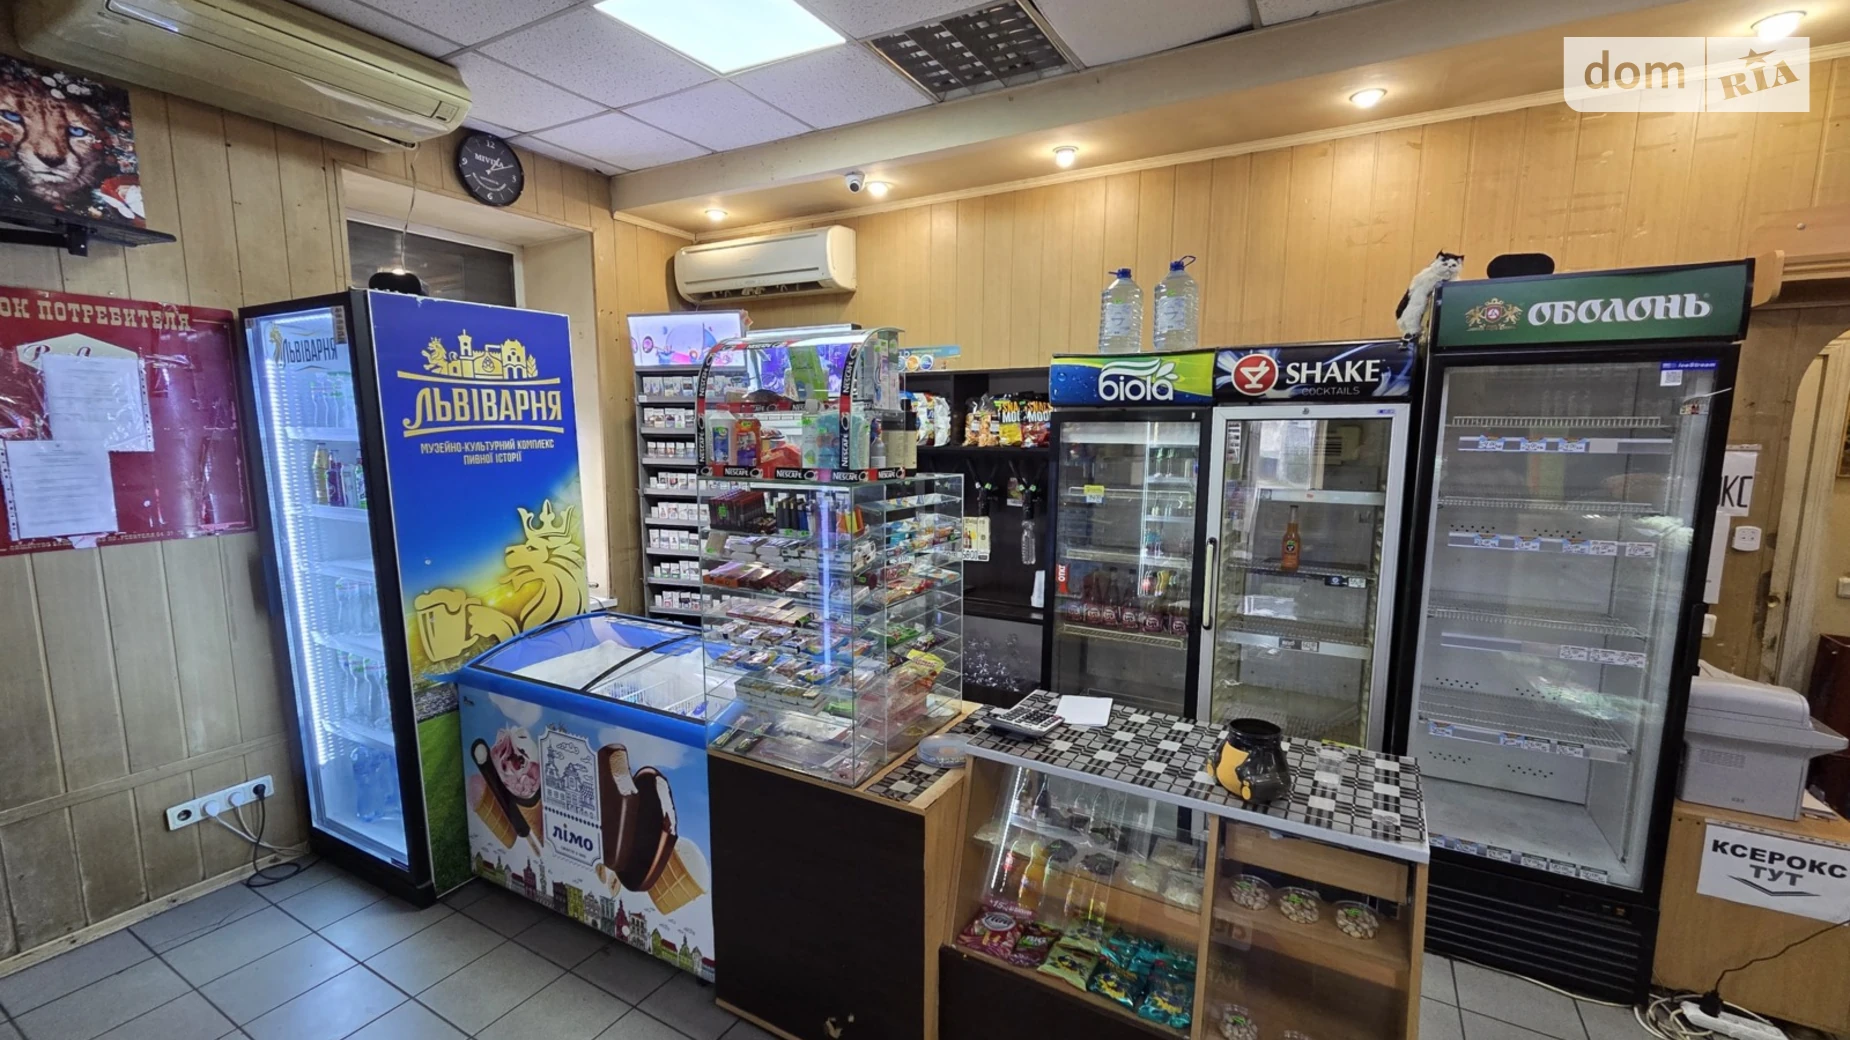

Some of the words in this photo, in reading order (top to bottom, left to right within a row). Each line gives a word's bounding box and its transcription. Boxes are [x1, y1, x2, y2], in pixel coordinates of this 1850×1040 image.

[485, 140, 495, 149] 12
[461, 157, 468, 165] 9
[486, 192, 493, 200] 6
[37, 300, 192, 331] ПОТРЕБИТЕЛЯ
[279, 337, 338, 368] ЛЬВІВАРНЯ
[1286, 359, 1381, 384] SHAKE
[1302, 386, 1360, 396] COCKTAILS
[402, 386, 563, 430] ЛЬВІВАРНЯ
[420, 438, 516, 454] МУЗЕЙНО-КУЛЬТУРНИЙ
[517, 438, 555, 450] КОМПЛЕКС
[463, 452, 494, 466] ПИВНОЇ
[495, 451, 522, 463] ІСТОРІЇ
[1719, 475, 1753, 508] КС
[553, 823, 594, 852] лімо
[1711, 839, 1847, 879] КСЕРОКС
[1749, 864, 1804, 887] ТУТ
